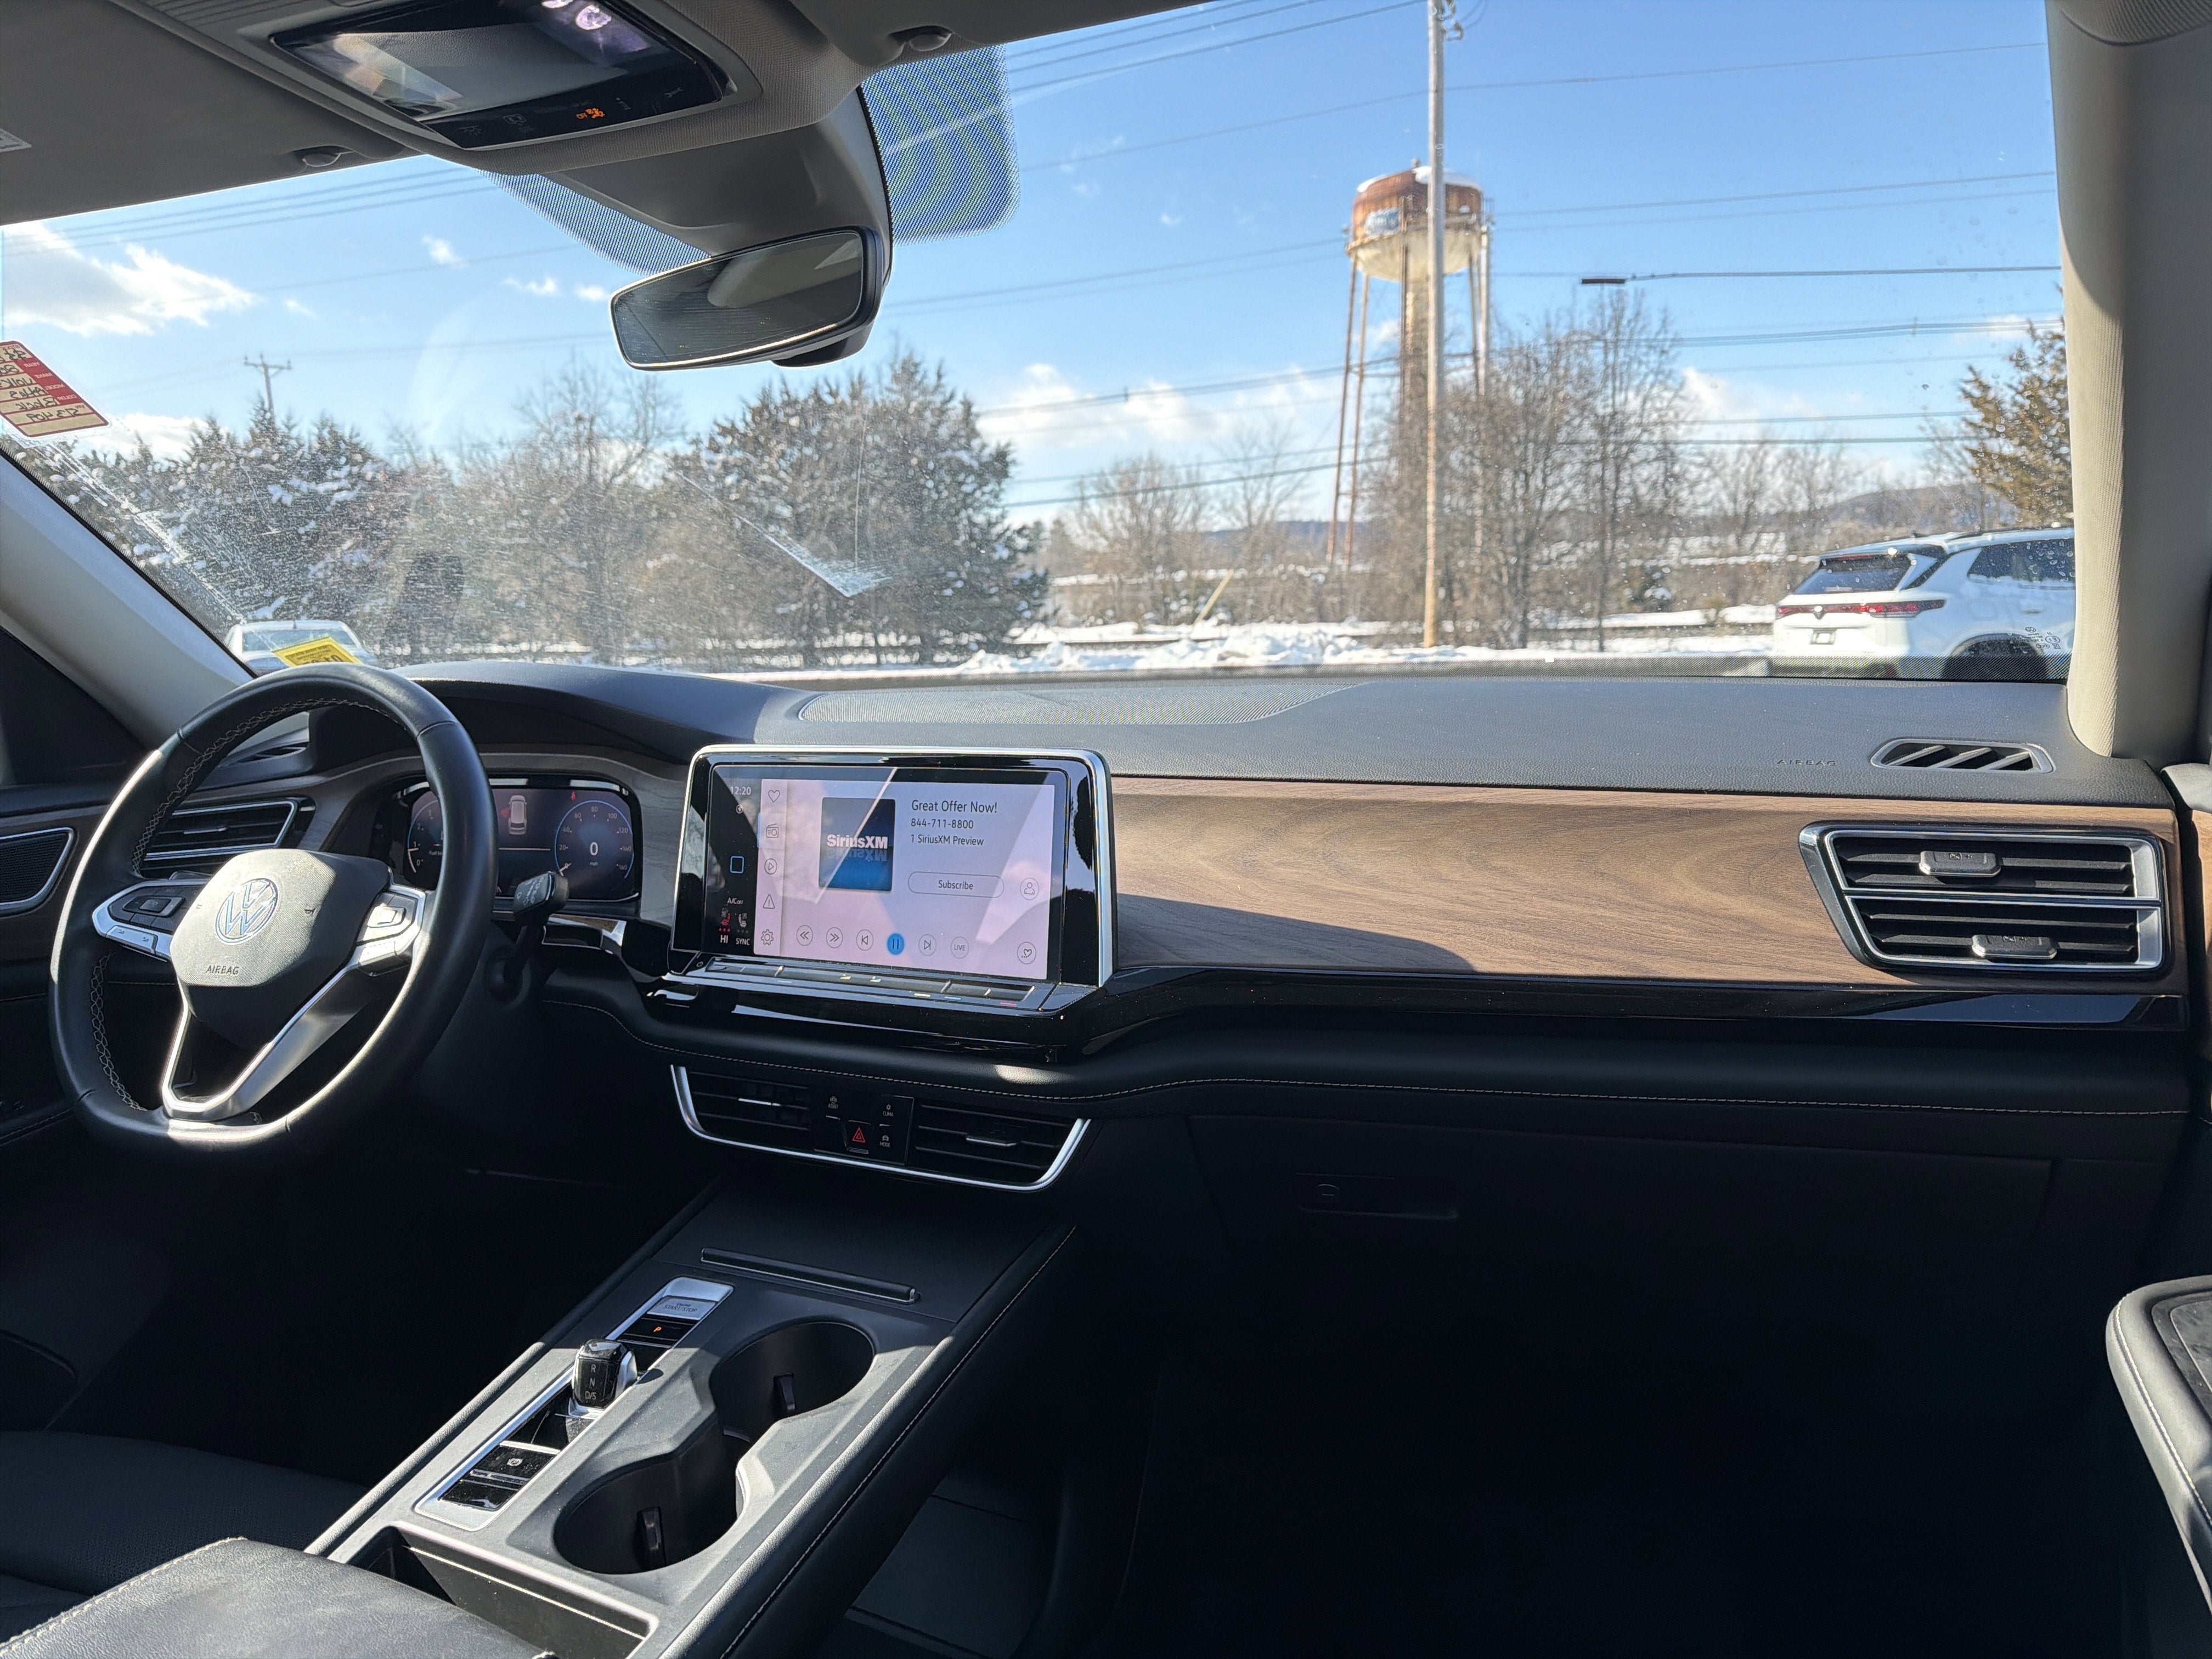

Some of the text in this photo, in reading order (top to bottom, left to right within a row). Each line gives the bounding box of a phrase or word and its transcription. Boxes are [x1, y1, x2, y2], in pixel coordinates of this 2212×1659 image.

[730, 786, 752, 795] 12:20
[911, 799, 997, 814] Great Offer Now!
[911, 817, 974, 829] 844-711-8800
[826, 834, 888, 849] SiriusXM
[911, 834, 984, 845] 1 SiriusXM Preview
[590, 842, 599, 856] 0
[938, 879, 974, 890] Subscribe
[720, 934, 729, 944] HI
[735, 938, 751, 946] SYNC
[206, 965, 239, 975] AIRBAG
[591, 1364, 596, 1373] R
[589, 1378, 595, 1387] N
[585, 1391, 596, 1400] D/S
